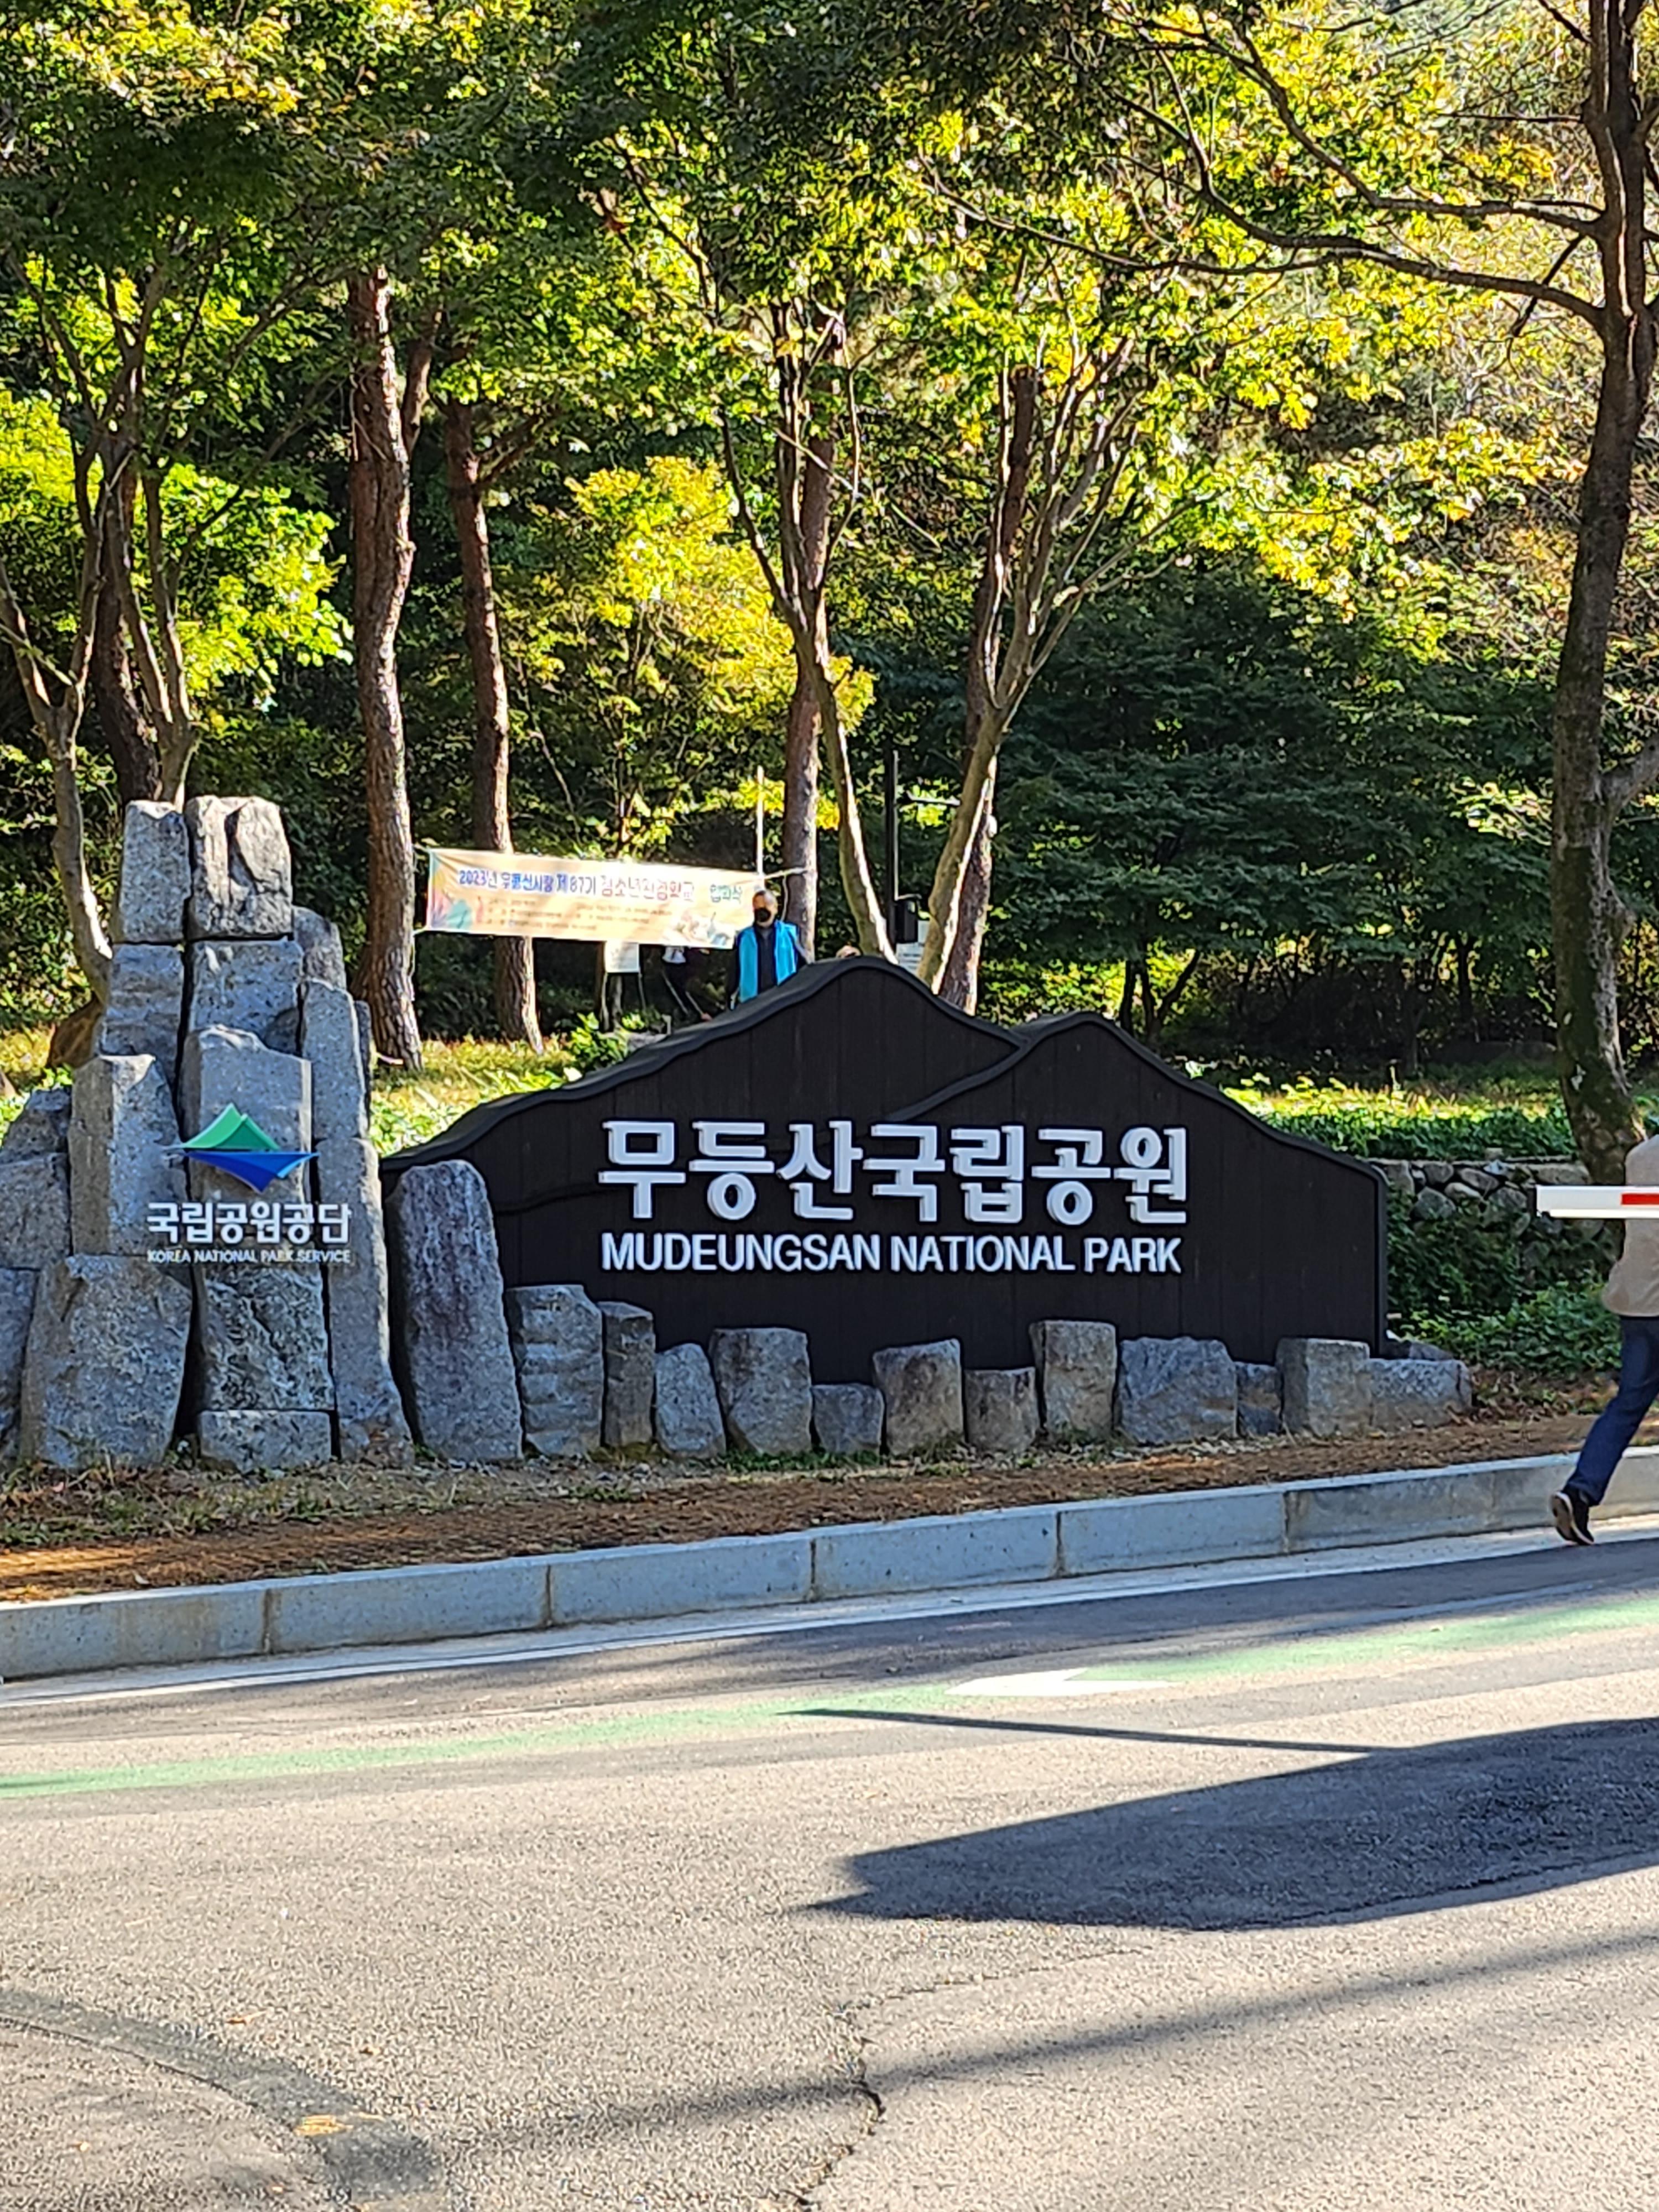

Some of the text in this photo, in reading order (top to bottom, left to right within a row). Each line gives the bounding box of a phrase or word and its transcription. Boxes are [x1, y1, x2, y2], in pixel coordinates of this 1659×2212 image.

[459, 869, 497, 888] 2023년
[598, 1120, 1187, 1225] 무등산국립공원
[147, 1201, 352, 1244] 국립공원공단
[147, 1249, 351, 1264] KOREA NATIONAL PARK SERVICE
[601, 1232, 1182, 1273] MUDEUNGSAN NATIONAL PARK
